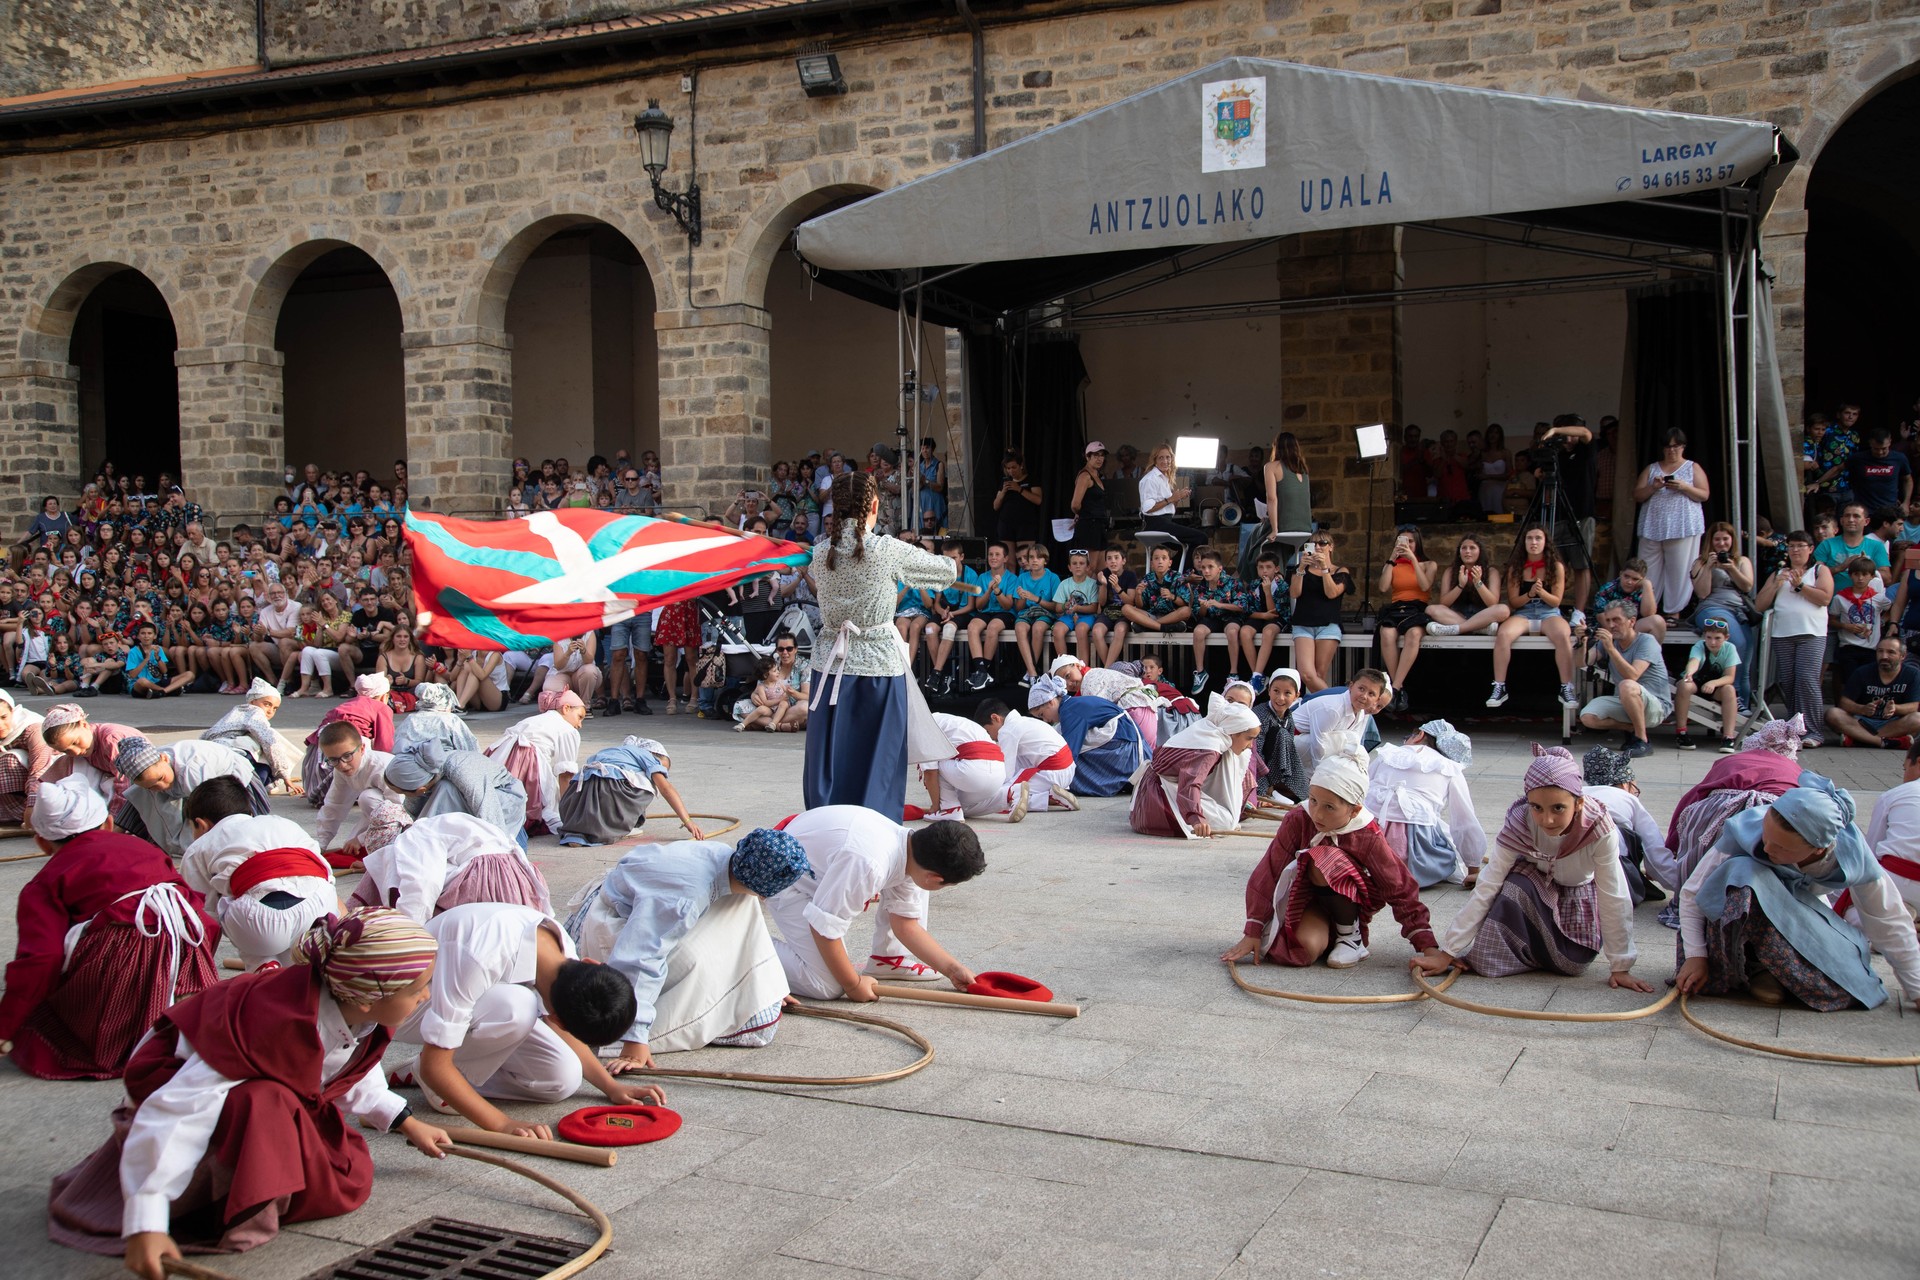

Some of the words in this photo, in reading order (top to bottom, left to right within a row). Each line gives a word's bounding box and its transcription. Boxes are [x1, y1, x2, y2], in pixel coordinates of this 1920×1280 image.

[1642, 141, 1717, 164] LARGAY
[1642, 174, 1660, 190] 94
[1664, 170, 1690, 188] 615
[1696, 167, 1713, 184] 33
[1718, 164, 1735, 181] 57
[1089, 186, 1264, 235] ANTZUOLAKO
[1300, 171, 1393, 214] UDALA
